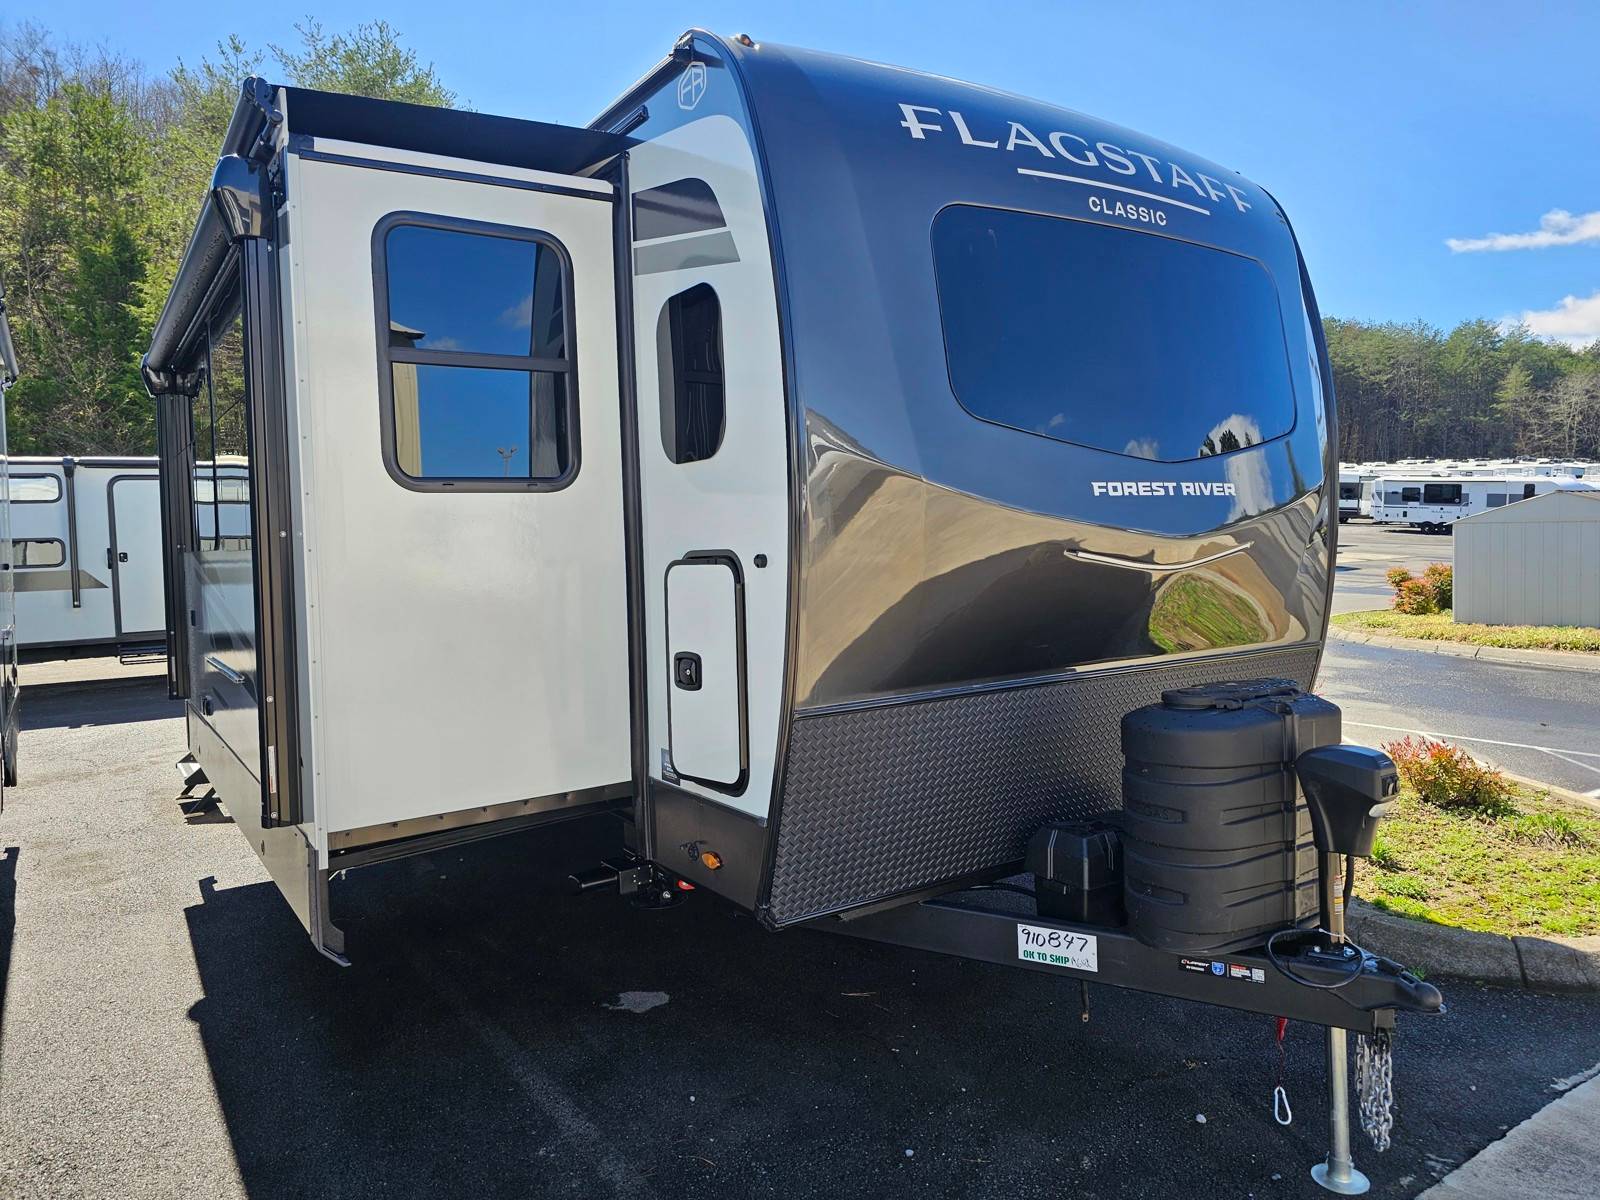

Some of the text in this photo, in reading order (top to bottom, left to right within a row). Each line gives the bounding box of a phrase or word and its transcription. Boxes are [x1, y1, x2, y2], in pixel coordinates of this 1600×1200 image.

[898, 102, 1252, 213] FLAGSTAFF
[1088, 196, 1167, 226] CLASSIC
[1091, 481, 1237, 497] FOREST RIVER
[1021, 928, 1089, 952] 910847
[1023, 949, 1035, 960] OK
[1037, 951, 1047, 961] TO
[1049, 953, 1070, 965] SHIP
